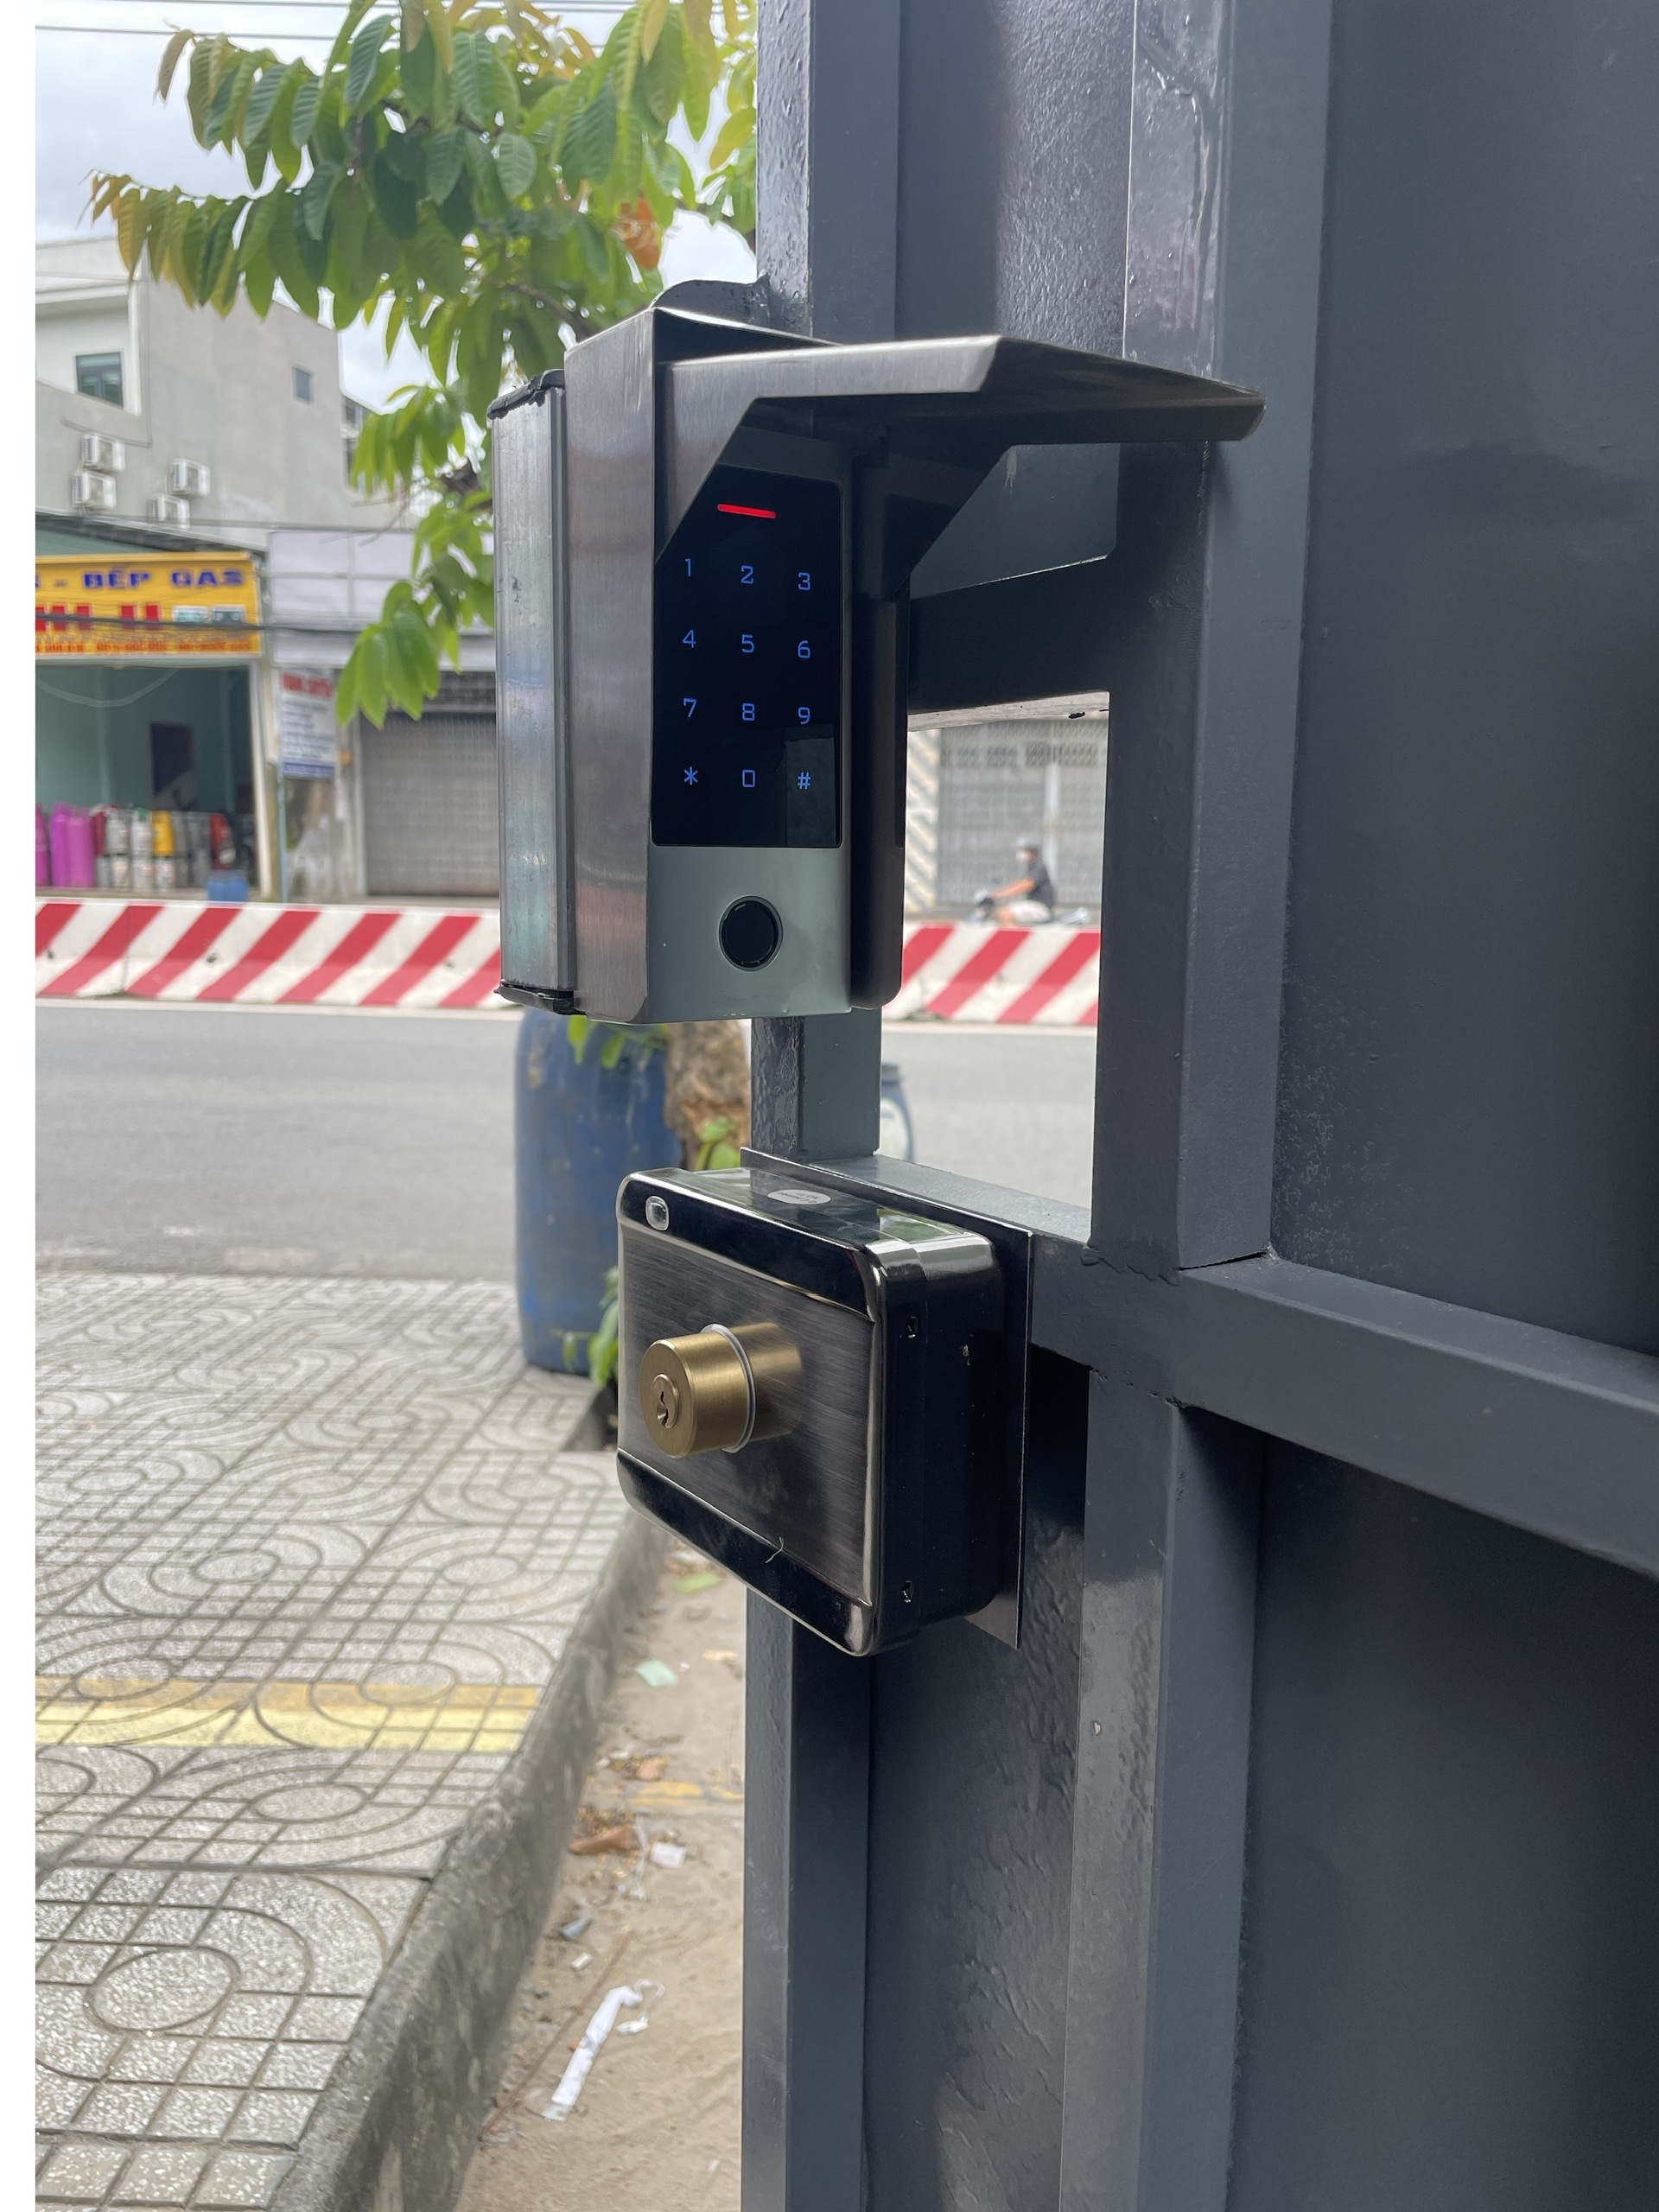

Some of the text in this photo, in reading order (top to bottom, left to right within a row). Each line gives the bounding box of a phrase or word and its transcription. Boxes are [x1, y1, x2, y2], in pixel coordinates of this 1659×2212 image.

[171, 570, 243, 586] GAS
[684, 558, 810, 591] 1 2 3
[682, 629, 810, 659] 4 5 6
[683, 697, 810, 725] 7 8 9
[741, 769, 756, 788] 0
[797, 772, 811, 790] #
